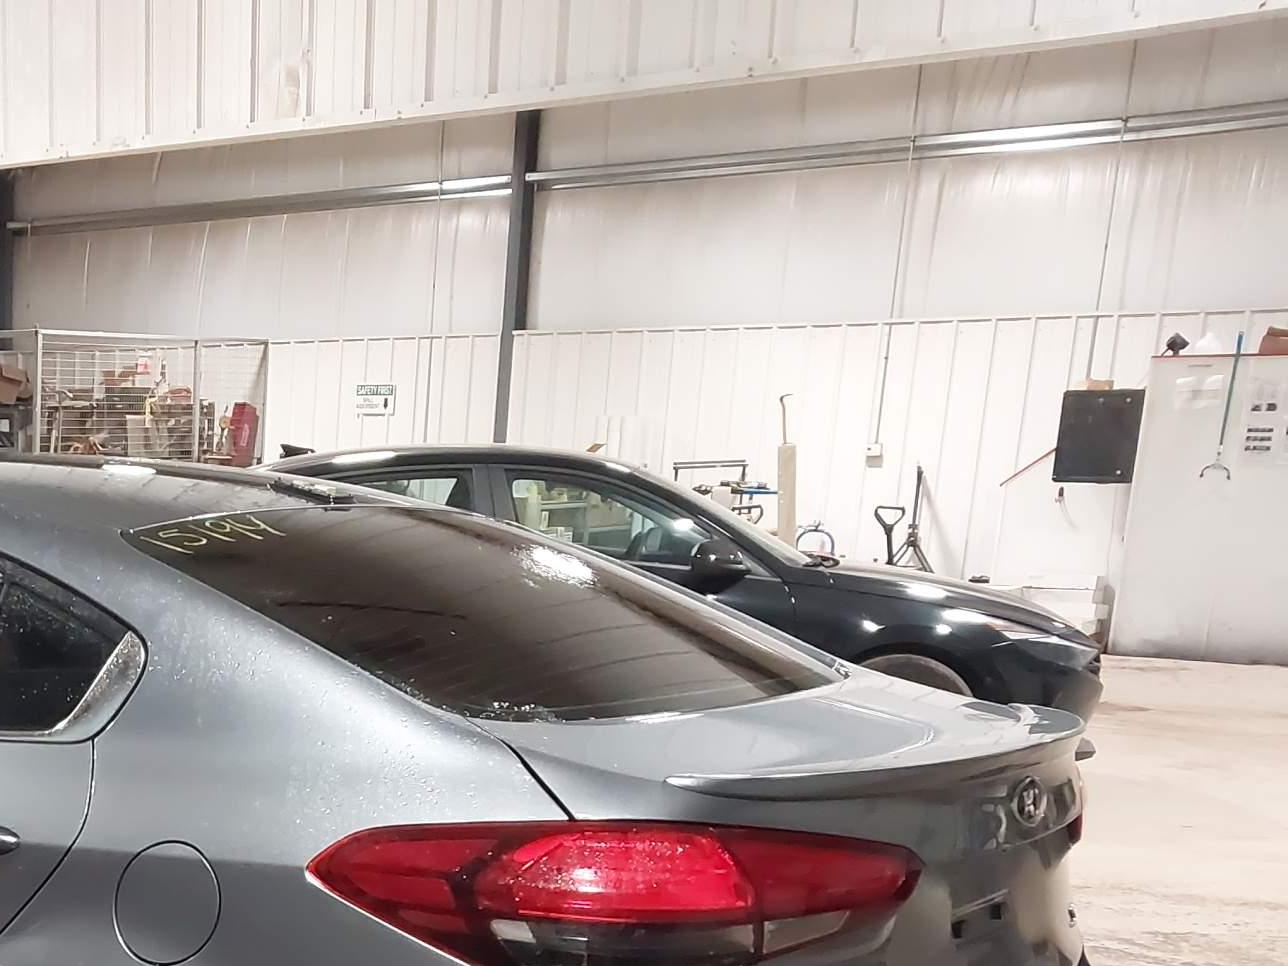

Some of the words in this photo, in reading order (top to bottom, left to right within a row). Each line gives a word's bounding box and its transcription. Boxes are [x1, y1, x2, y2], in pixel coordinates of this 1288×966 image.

[357, 386, 377, 395] SAFETY
[378, 386, 392, 395] FIRST
[139, 514, 287, 554] 15194
